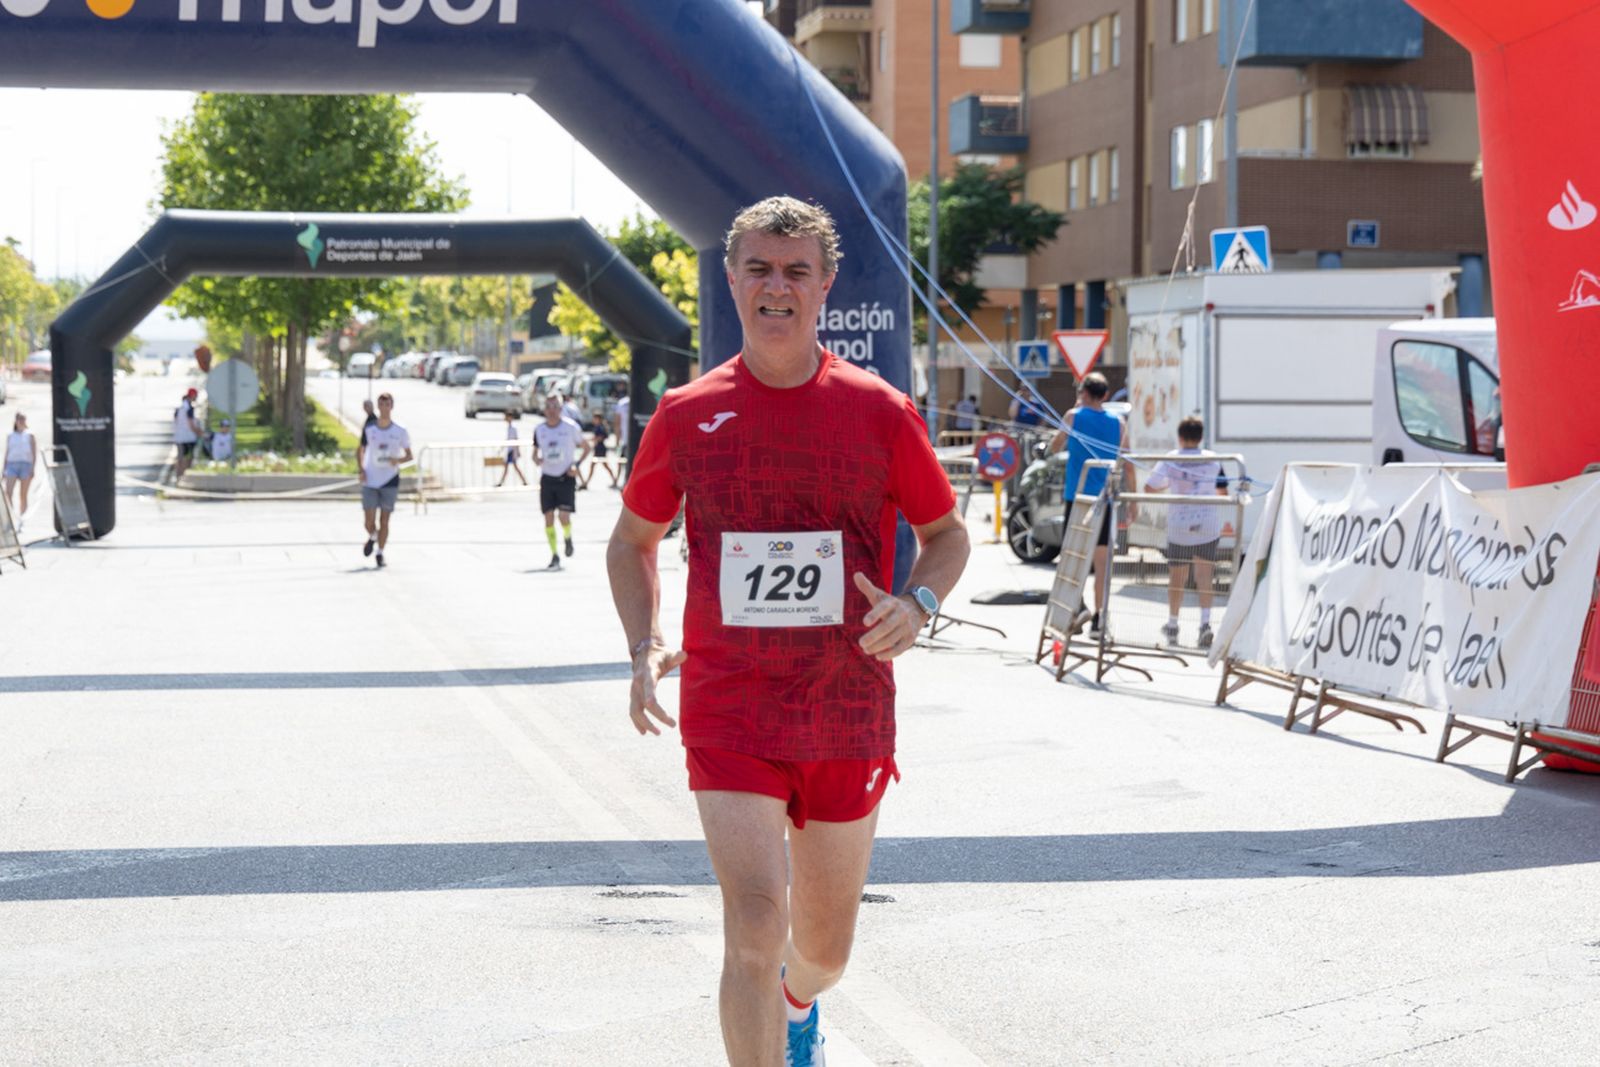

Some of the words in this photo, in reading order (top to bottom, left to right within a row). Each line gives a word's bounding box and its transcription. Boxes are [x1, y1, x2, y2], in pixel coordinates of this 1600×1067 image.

[326, 237, 380, 250] Patronato
[381, 237, 434, 252] Municipal
[435, 238, 451, 250] de
[326, 250, 377, 263] Deportes
[378, 250, 394, 262] de
[744, 563, 822, 601] 129
[1288, 583, 1407, 670] Deportes
[1408, 602, 1444, 677] de
